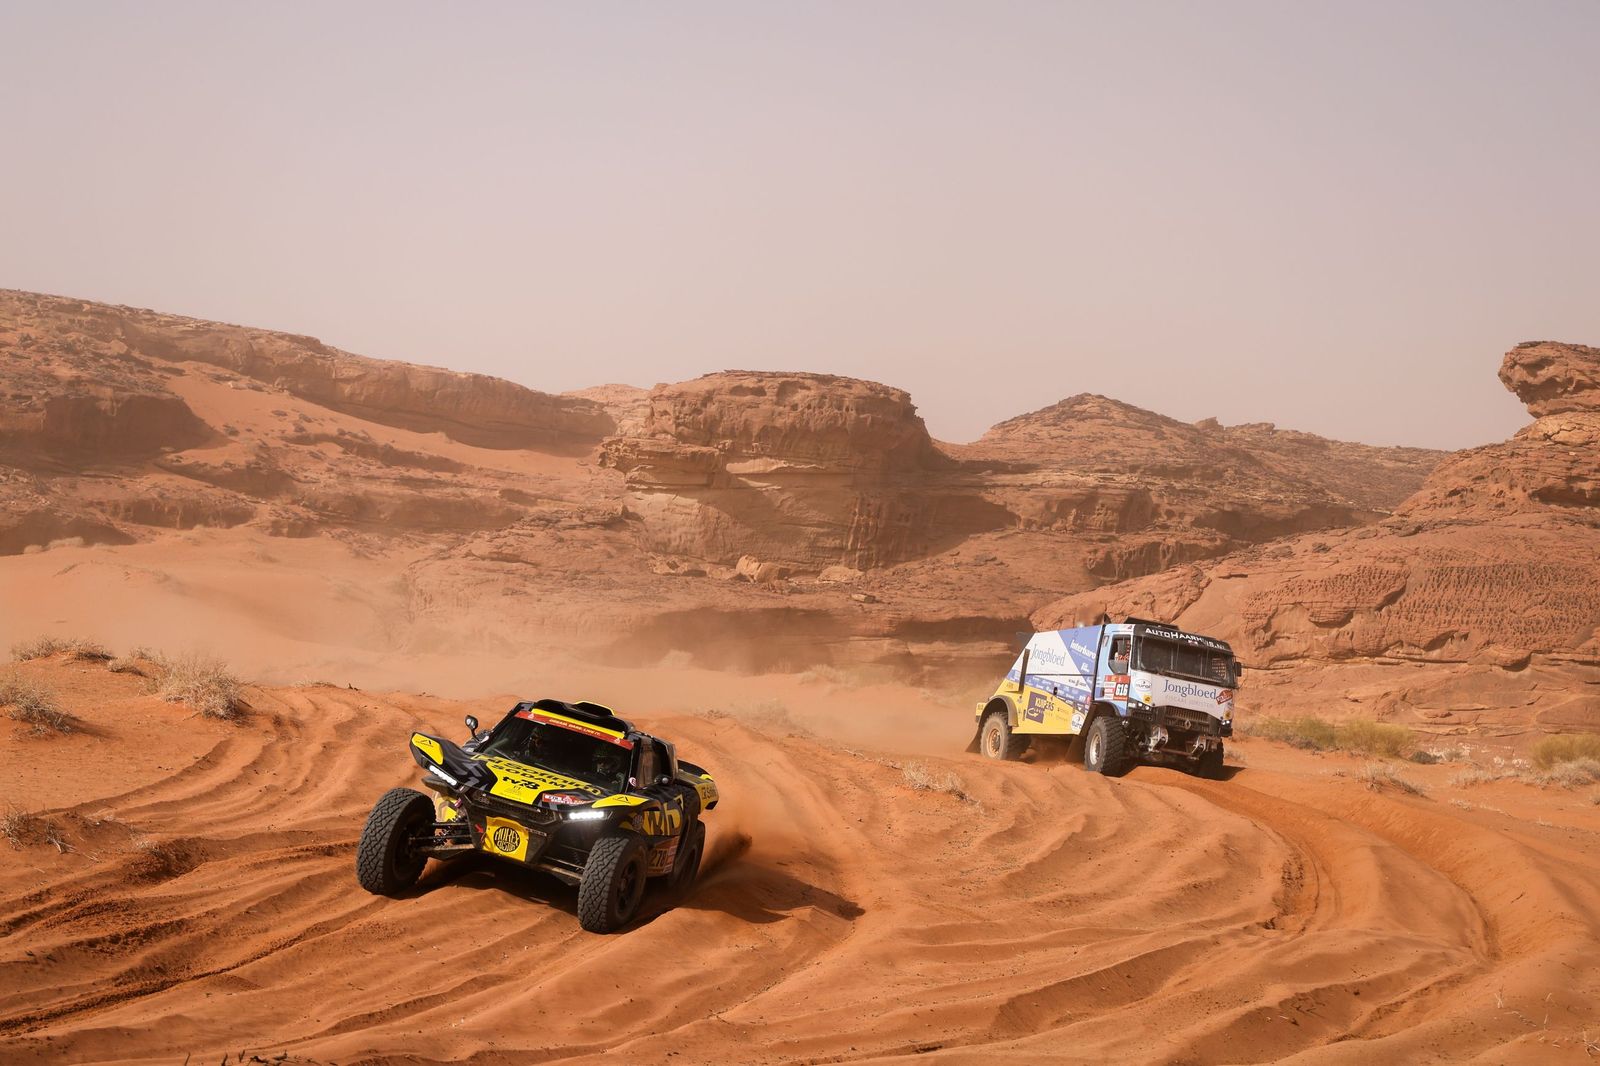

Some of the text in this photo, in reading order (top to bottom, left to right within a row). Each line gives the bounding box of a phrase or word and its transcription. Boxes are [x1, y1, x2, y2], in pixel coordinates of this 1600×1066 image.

[1031, 643, 1066, 666] Jongbloed
[1116, 683, 1128, 696] 616
[1163, 679, 1217, 700] Jongbloed
[491, 764, 567, 788] SODAM
